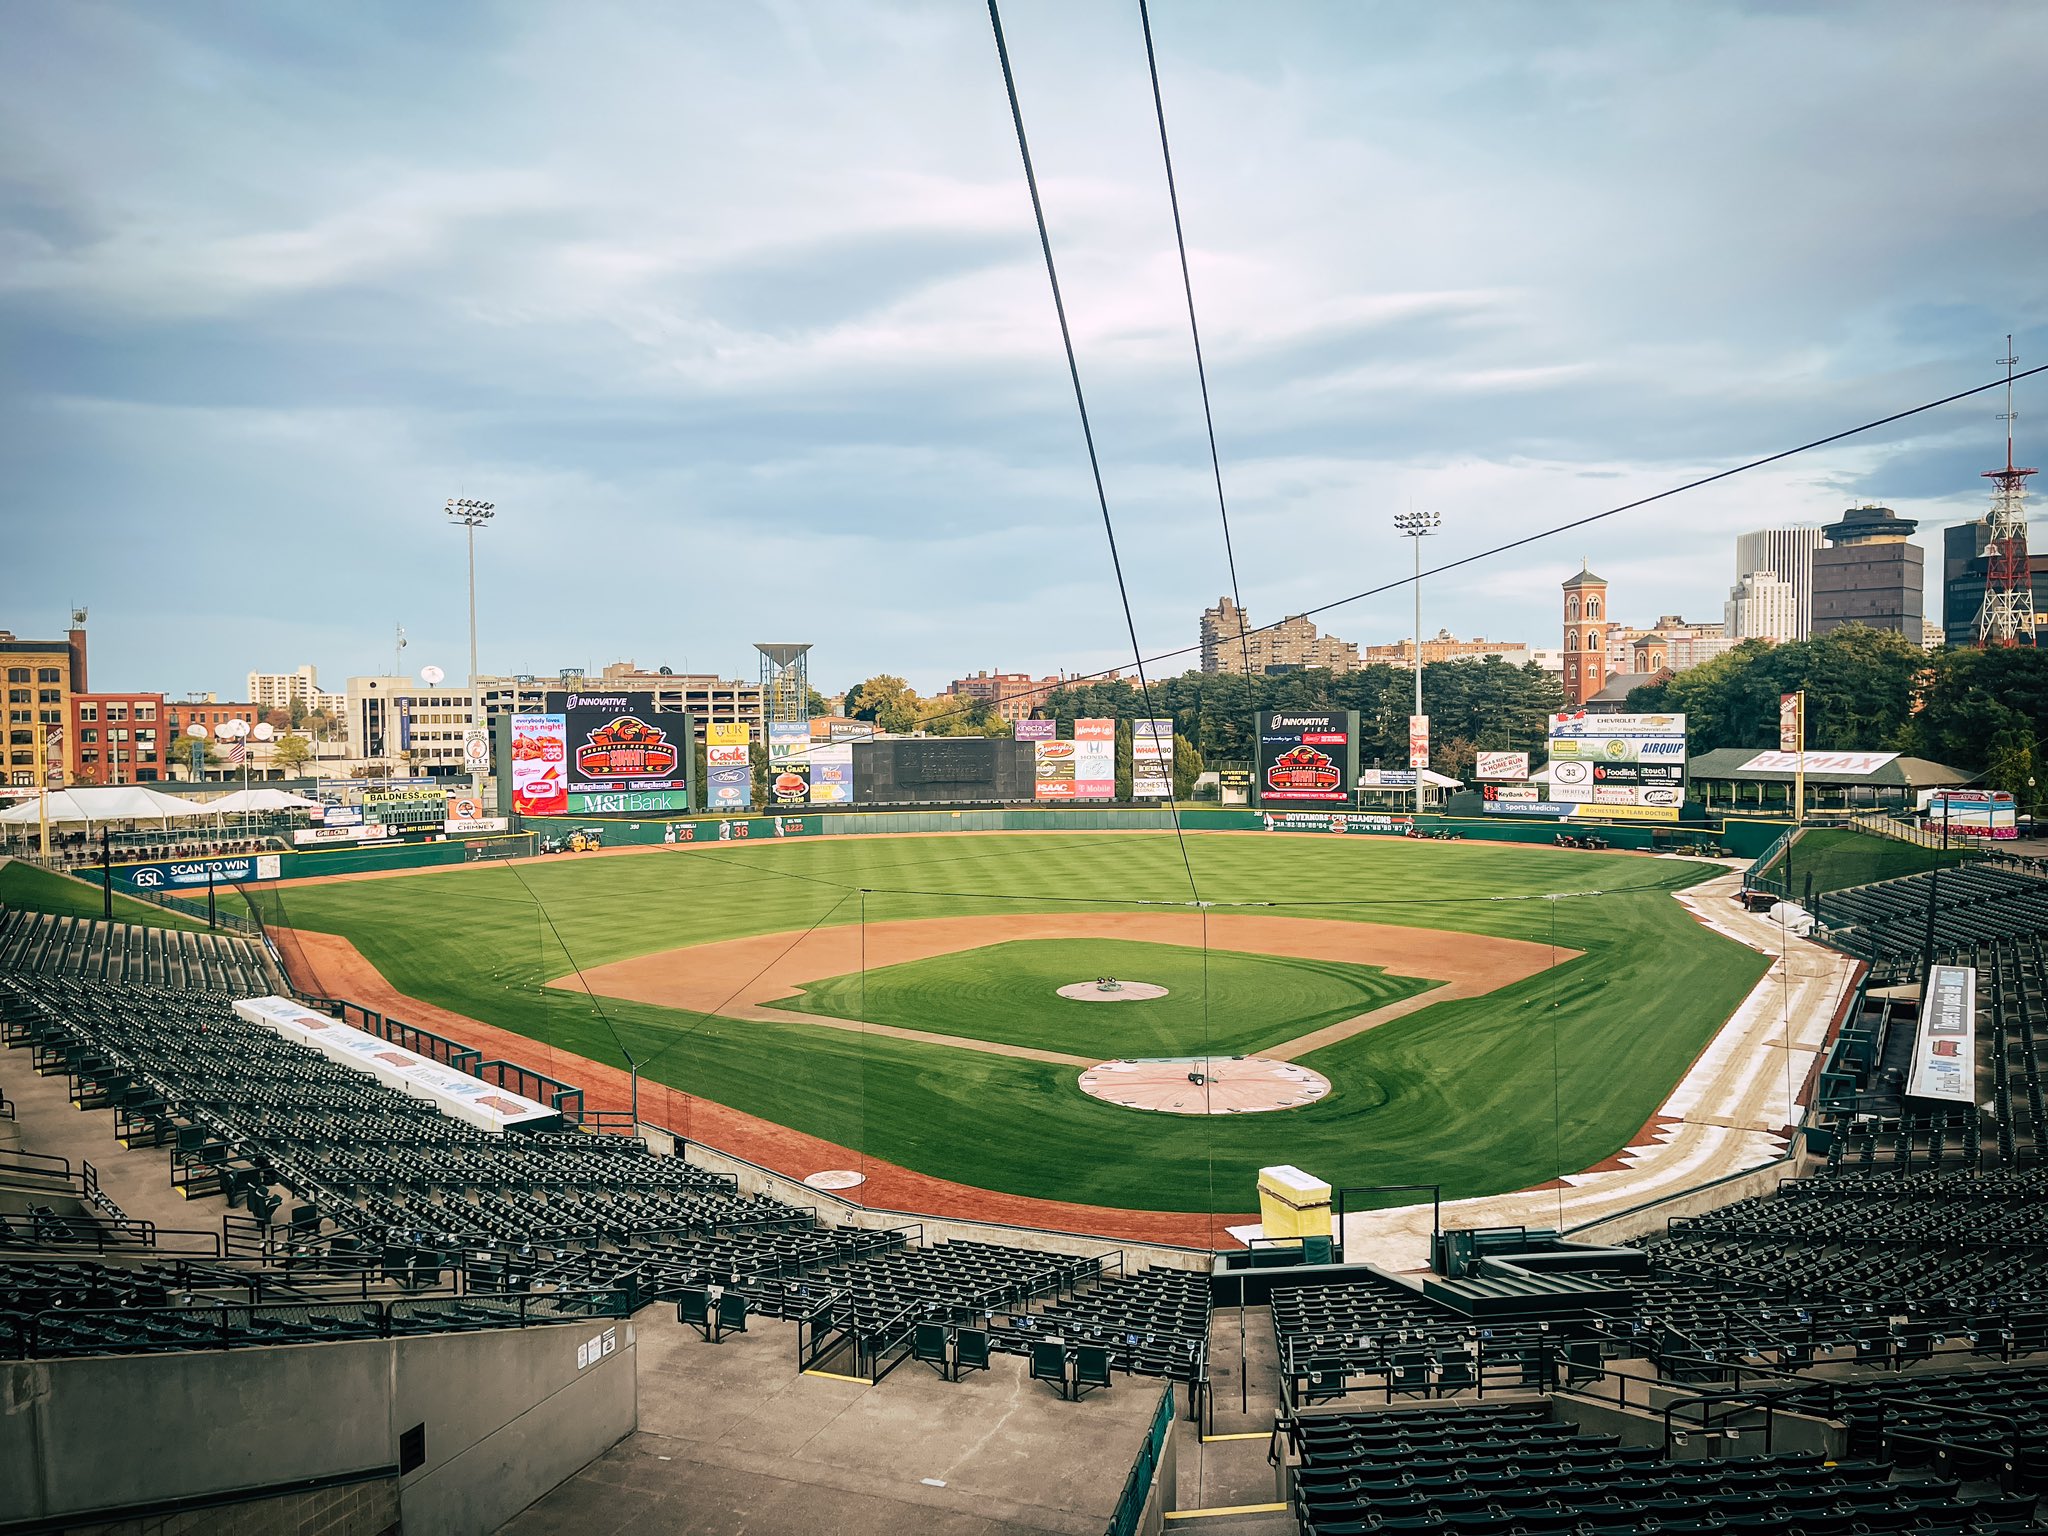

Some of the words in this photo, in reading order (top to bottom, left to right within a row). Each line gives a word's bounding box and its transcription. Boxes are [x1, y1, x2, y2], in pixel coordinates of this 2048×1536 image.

[579, 697, 627, 706] INNOVATIVE
[540, 723, 564, 731] night!
[1282, 718, 1329, 726] INNOVATIVE
[727, 725, 742, 734] UR
[1017, 723, 1042, 732] kinecta
[1077, 724, 1101, 735] Wendy's
[1145, 724, 1172, 733] SUMMIT
[582, 744, 626, 756] ROCHESTER
[709, 746, 747, 761] Castle
[1642, 743, 1684, 755] AIRQUIP
[610, 749, 645, 767] SUMMIT
[1749, 755, 1884, 770] RE/MAX
[771, 765, 785, 773] BILL
[1488, 761, 1507, 771] HOME
[1508, 757, 1523, 766] RUN
[719, 771, 739, 781] Ford
[1292, 770, 1316, 783] SUMMIT
[1565, 769, 1576, 777] 33
[1607, 768, 1637, 776] Foodlink
[1038, 783, 1067, 791] ISAAC
[370, 791, 441, 801] BALDNESS.com
[583, 794, 628, 813] M&T
[630, 792, 672, 810] Bank
[1505, 804, 1528, 812] Sports
[1529, 804, 1560, 812] Medicine
[1286, 813, 1330, 821] GOVERNORS'
[1347, 814, 1391, 824] CHAMPIONS
[733, 826, 749, 837] 36
[785, 824, 804, 832] 8,222
[679, 829, 694, 840] 26
[170, 863, 204, 876] SCAN
[205, 862, 223, 872] TO
[224, 859, 249, 870] WIN
[1934, 1013, 1960, 1030] There's
